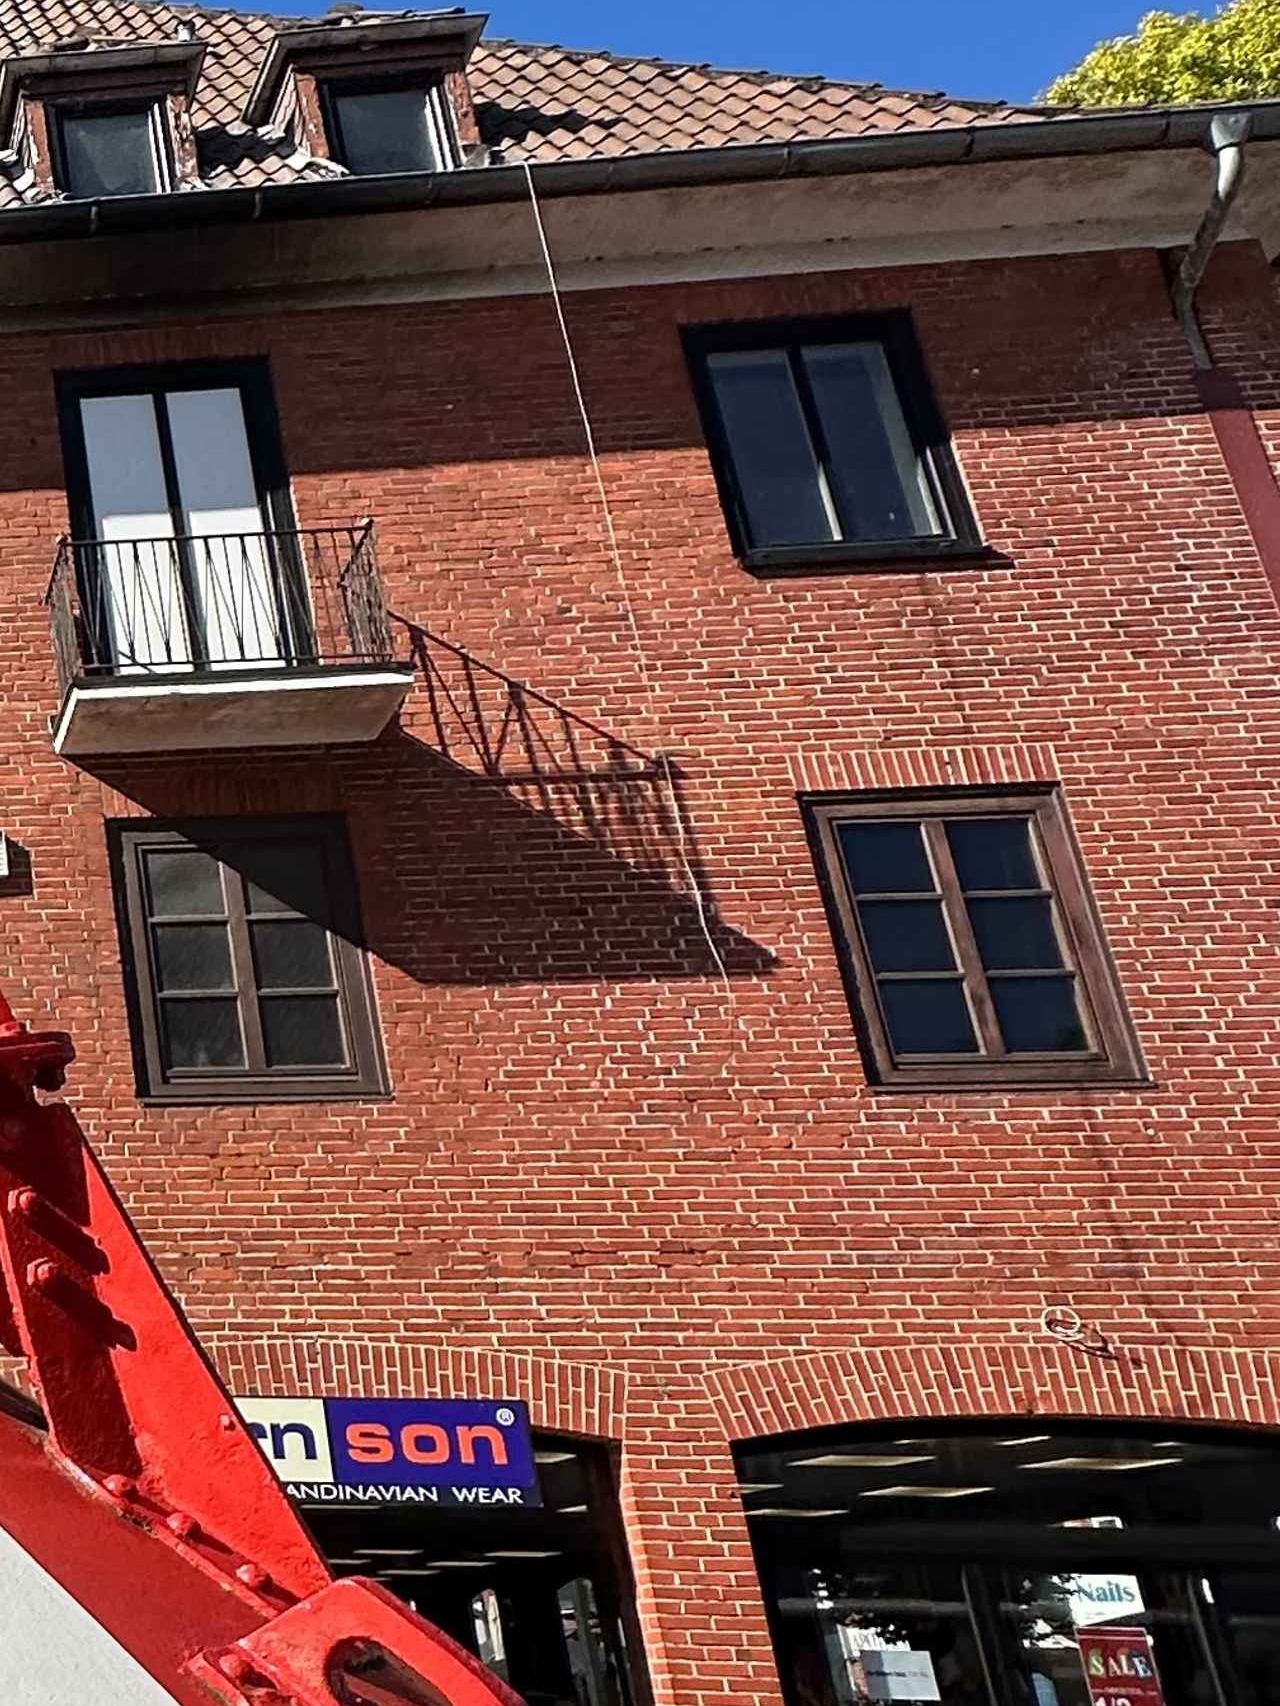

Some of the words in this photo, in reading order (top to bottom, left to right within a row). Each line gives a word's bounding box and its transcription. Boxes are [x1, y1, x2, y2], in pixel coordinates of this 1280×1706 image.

[345, 1422, 509, 1466] son
[451, 1486, 524, 1505] WEAR
[1076, 1579, 1136, 1603] Nails
[1090, 1648, 1153, 1679] SALE
